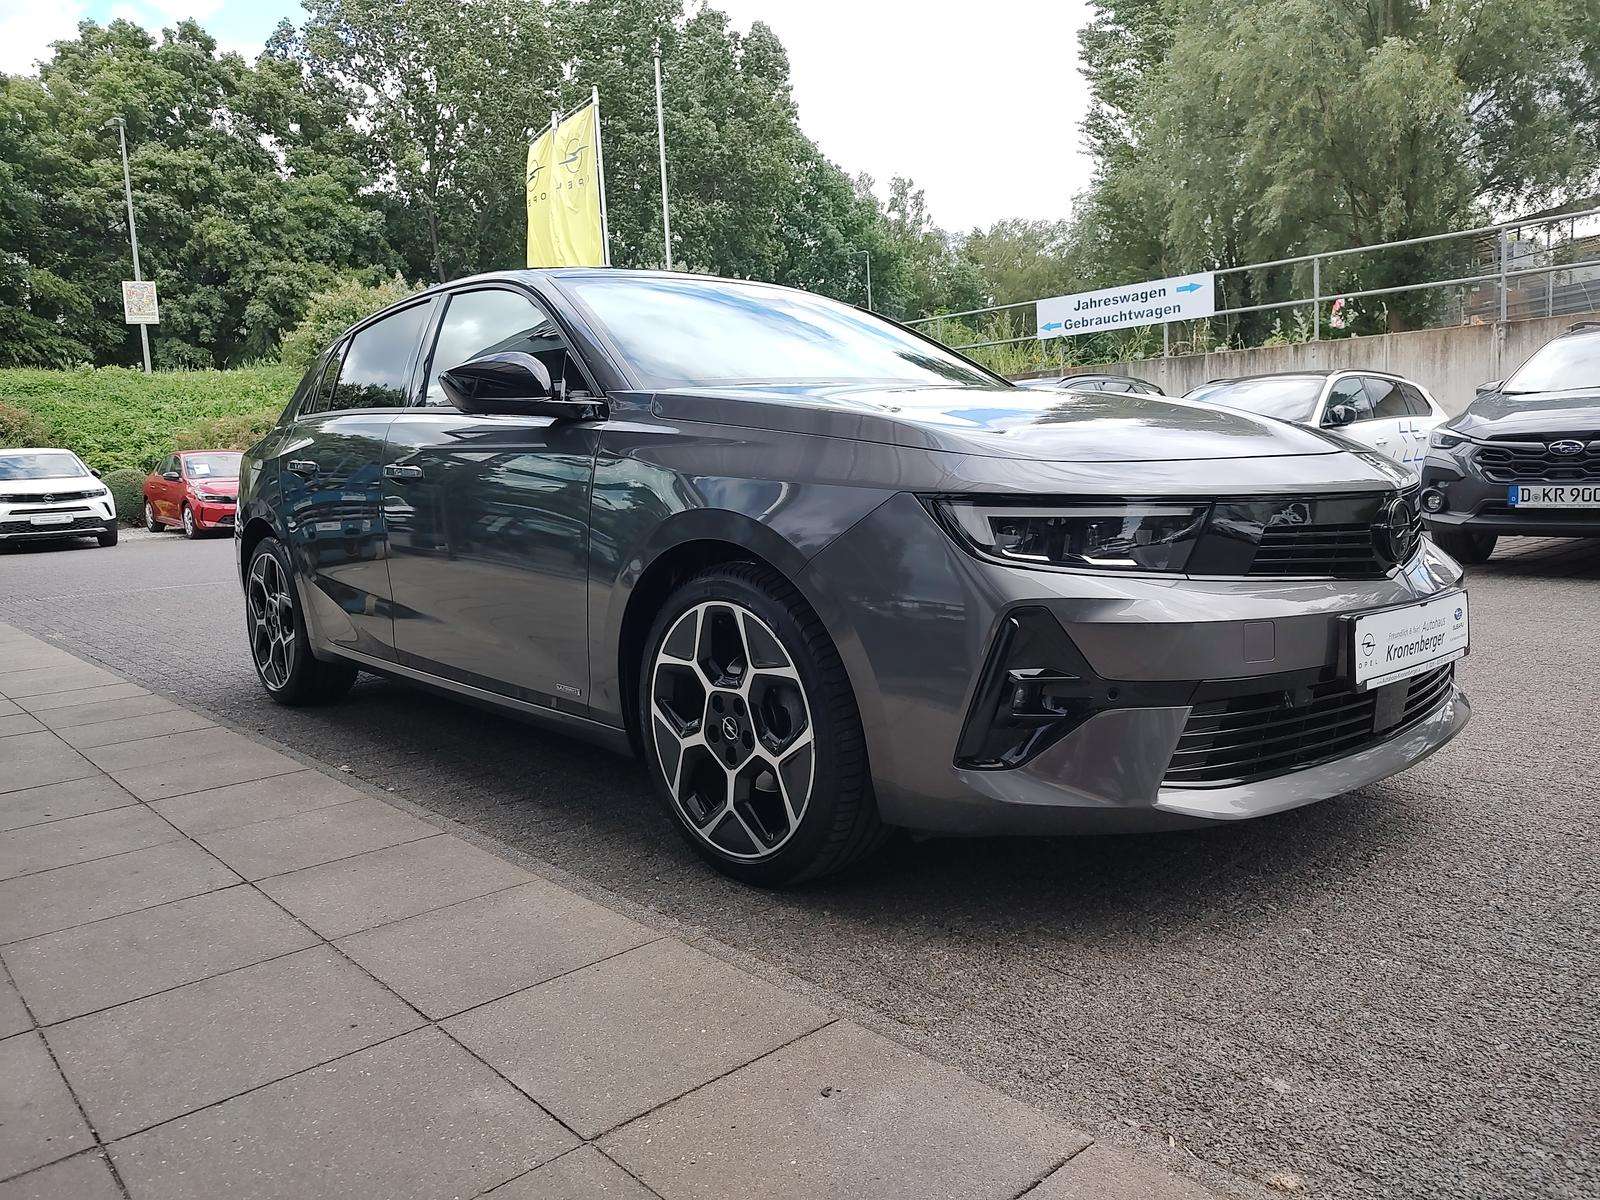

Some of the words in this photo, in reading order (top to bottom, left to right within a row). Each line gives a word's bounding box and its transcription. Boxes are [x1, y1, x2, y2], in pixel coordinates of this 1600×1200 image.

[1073, 286, 1167, 312] Jahreswagen
[1064, 303, 1181, 330] Gebrauchtwagen
[1542, 488, 1565, 502] KR
[1385, 632, 1446, 662] Kronenberger
